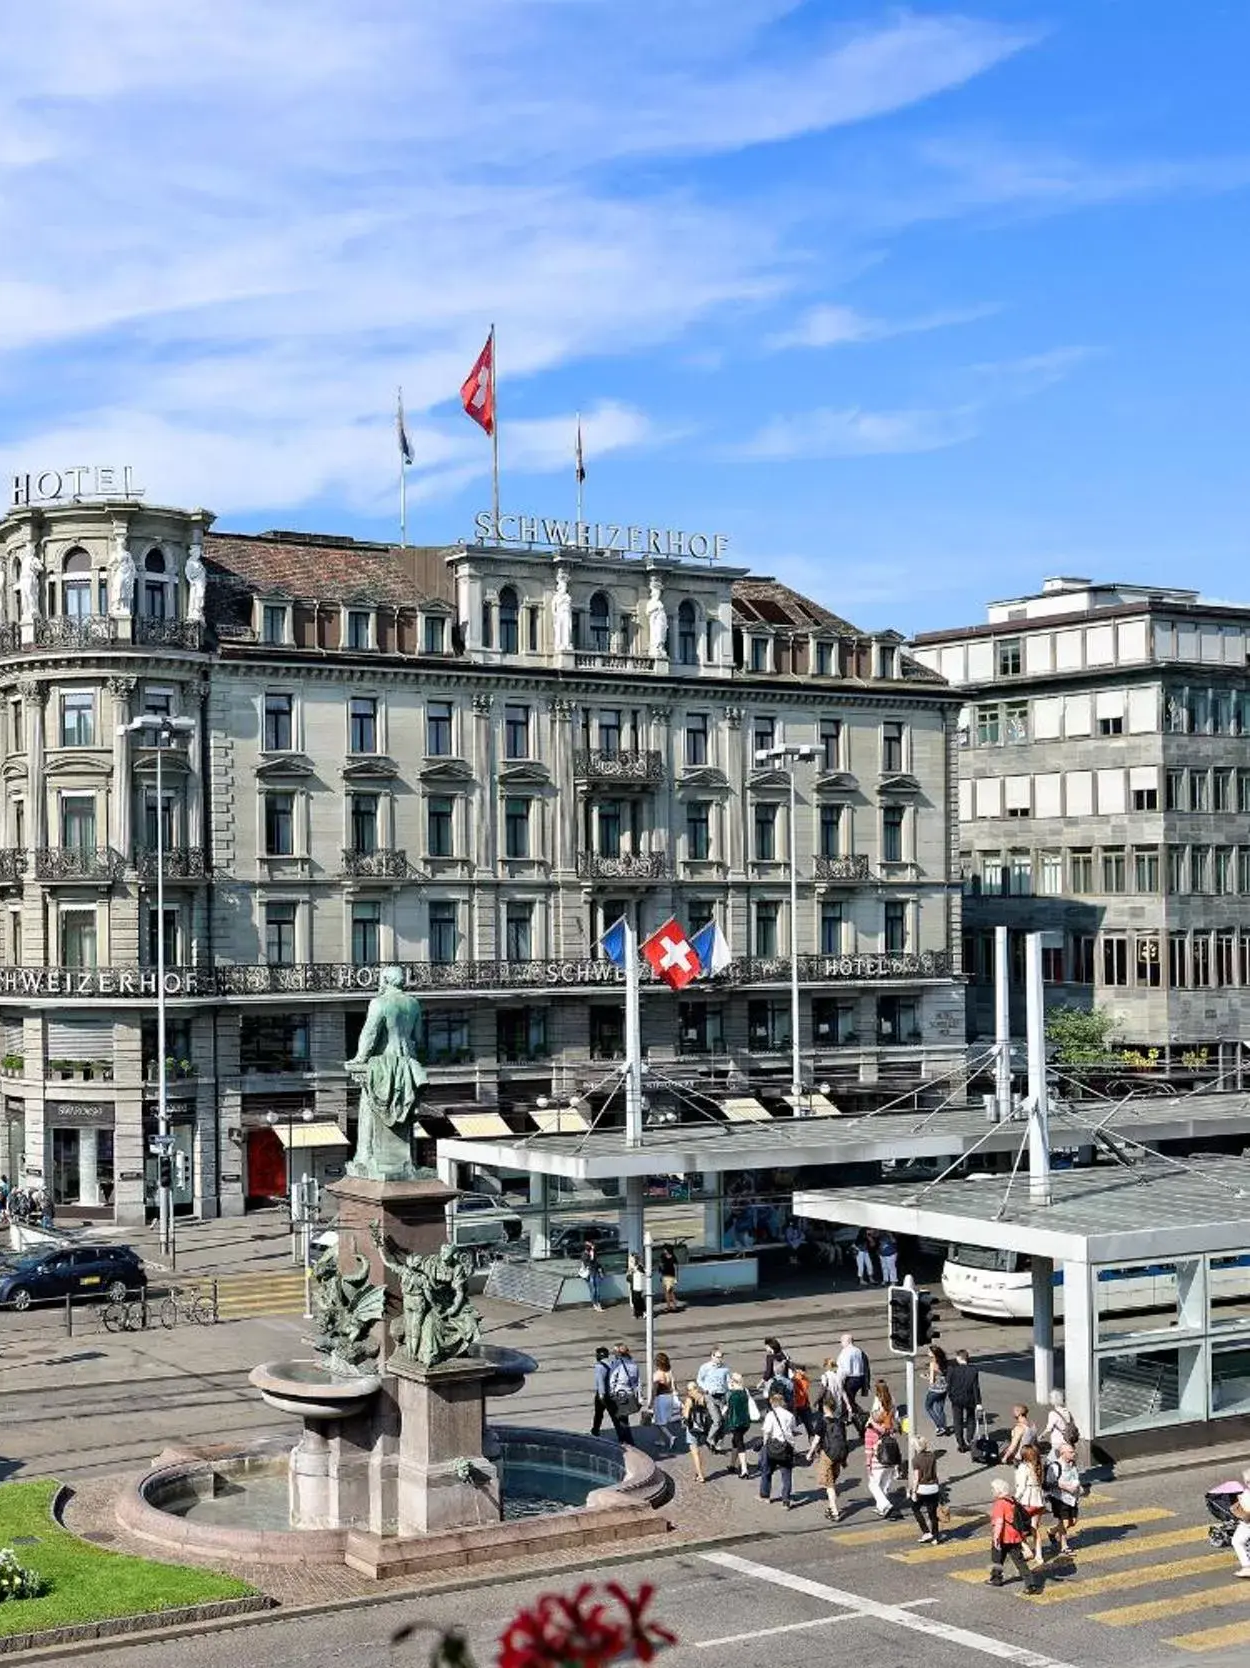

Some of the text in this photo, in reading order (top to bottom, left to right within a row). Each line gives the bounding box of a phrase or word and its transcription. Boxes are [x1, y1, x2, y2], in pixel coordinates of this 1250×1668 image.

[13, 466, 146, 506] HOTEL
[475, 511, 730, 559] SCHWEIZERHOF
[825, 957, 889, 976] HOTEL
